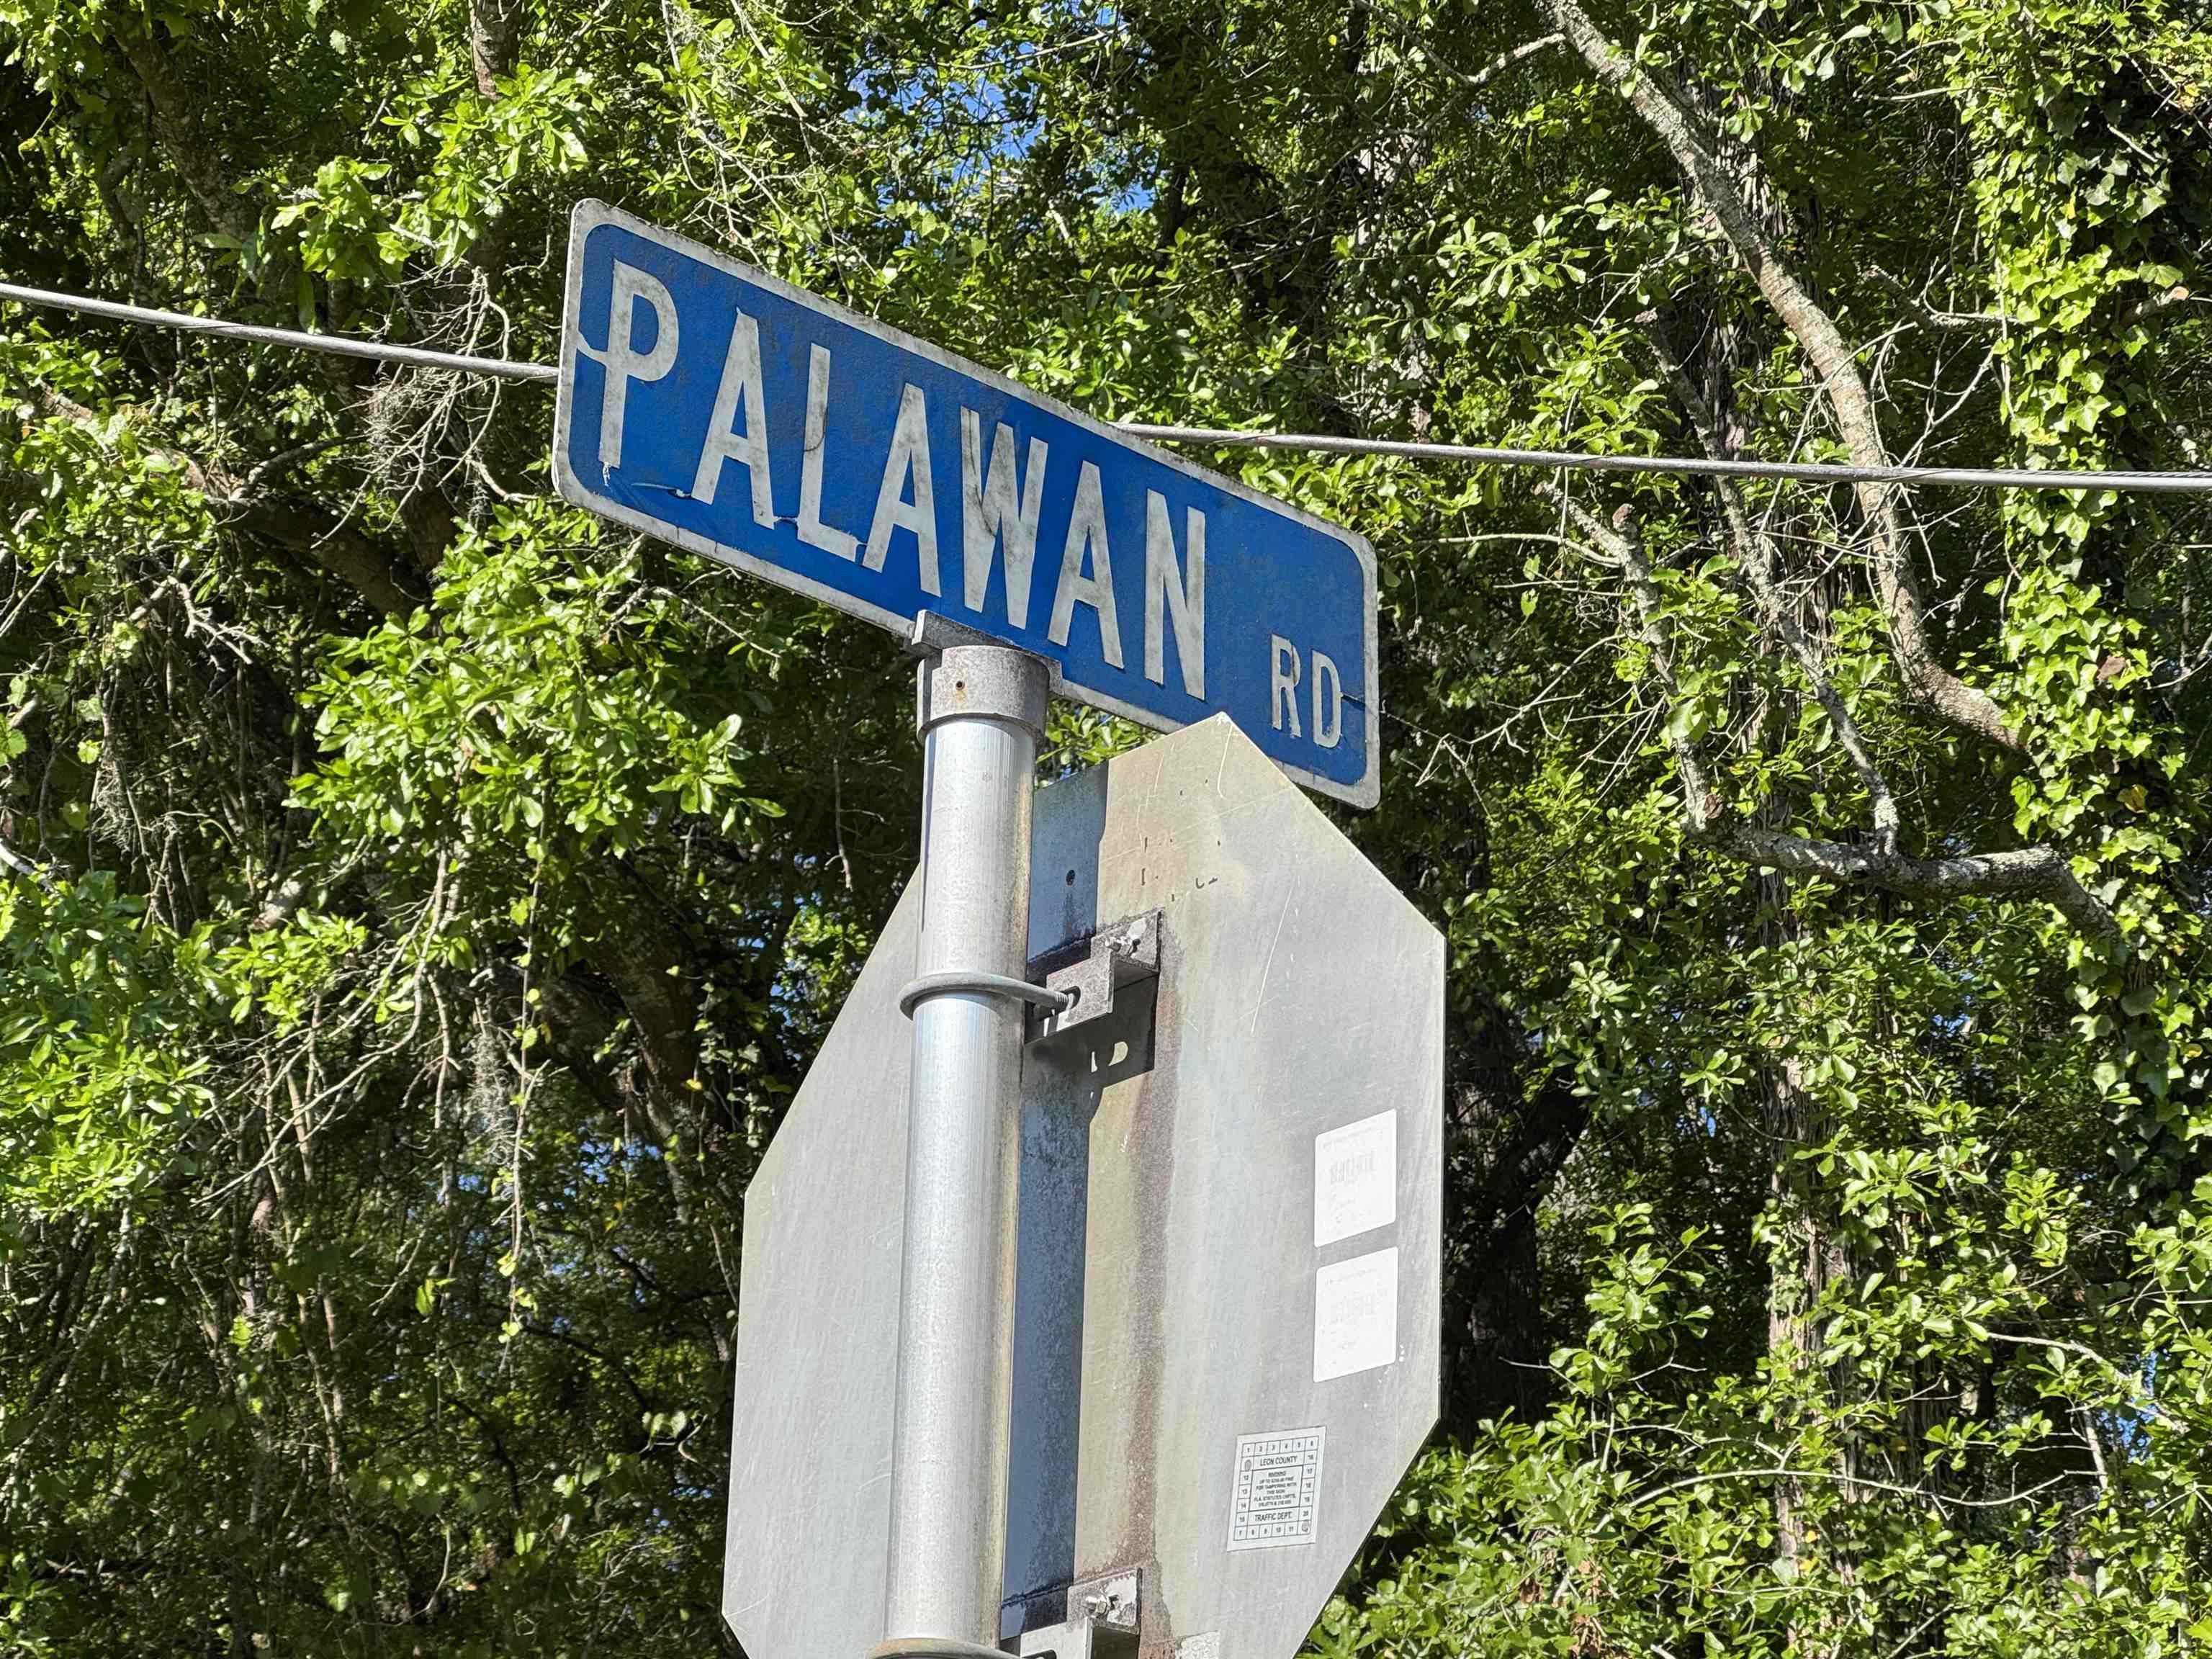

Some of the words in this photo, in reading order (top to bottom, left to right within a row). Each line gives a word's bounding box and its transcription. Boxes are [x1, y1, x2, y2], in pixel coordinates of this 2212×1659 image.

[598, 258, 1205, 701] PALAWAN
[1270, 633, 1342, 749] RD
[1260, 1457, 1274, 1466] LEON
[1275, 1455, 1298, 1465] COUNTY
[1255, 1513, 1277, 1521] TRAFFIC
